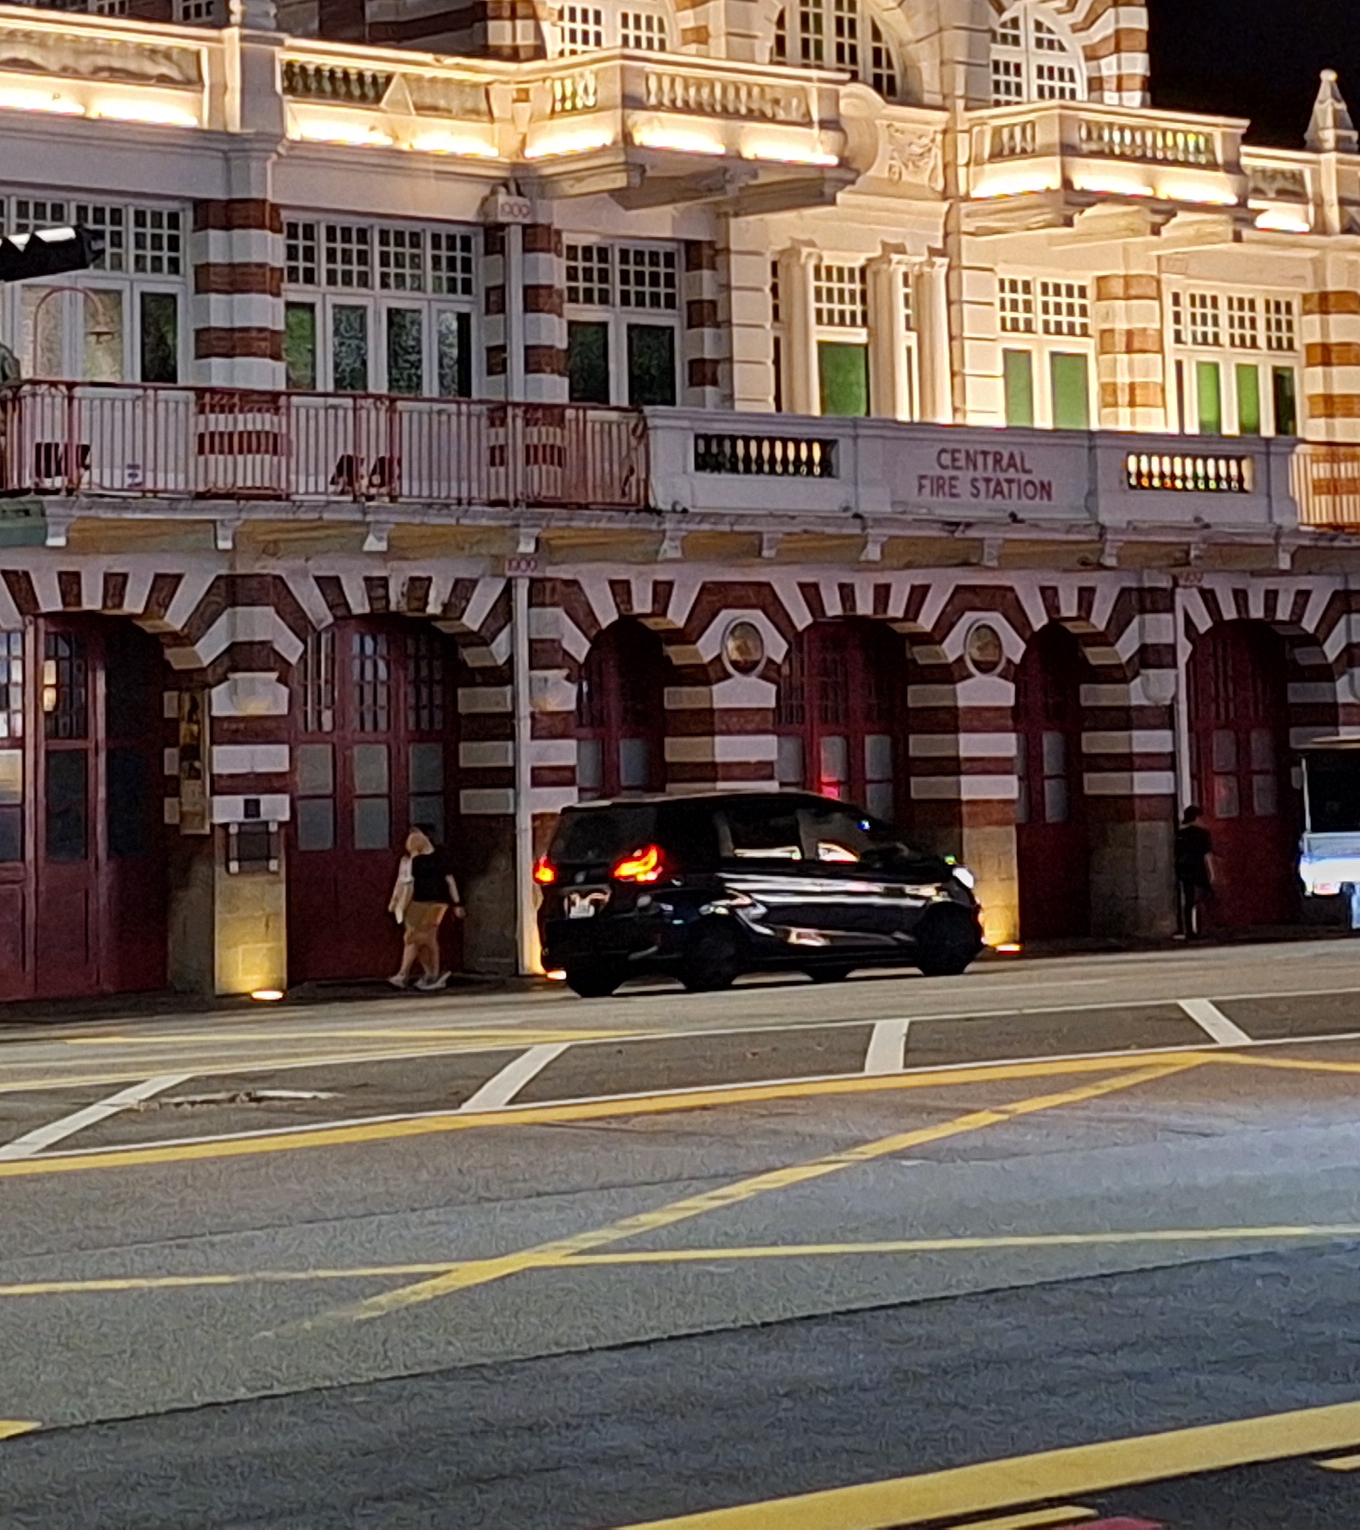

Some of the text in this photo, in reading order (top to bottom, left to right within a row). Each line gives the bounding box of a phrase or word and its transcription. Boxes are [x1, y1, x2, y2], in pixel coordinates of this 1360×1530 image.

[936, 447, 1033, 474] CENTRAL
[917, 474, 1053, 502] FIRE STATION
